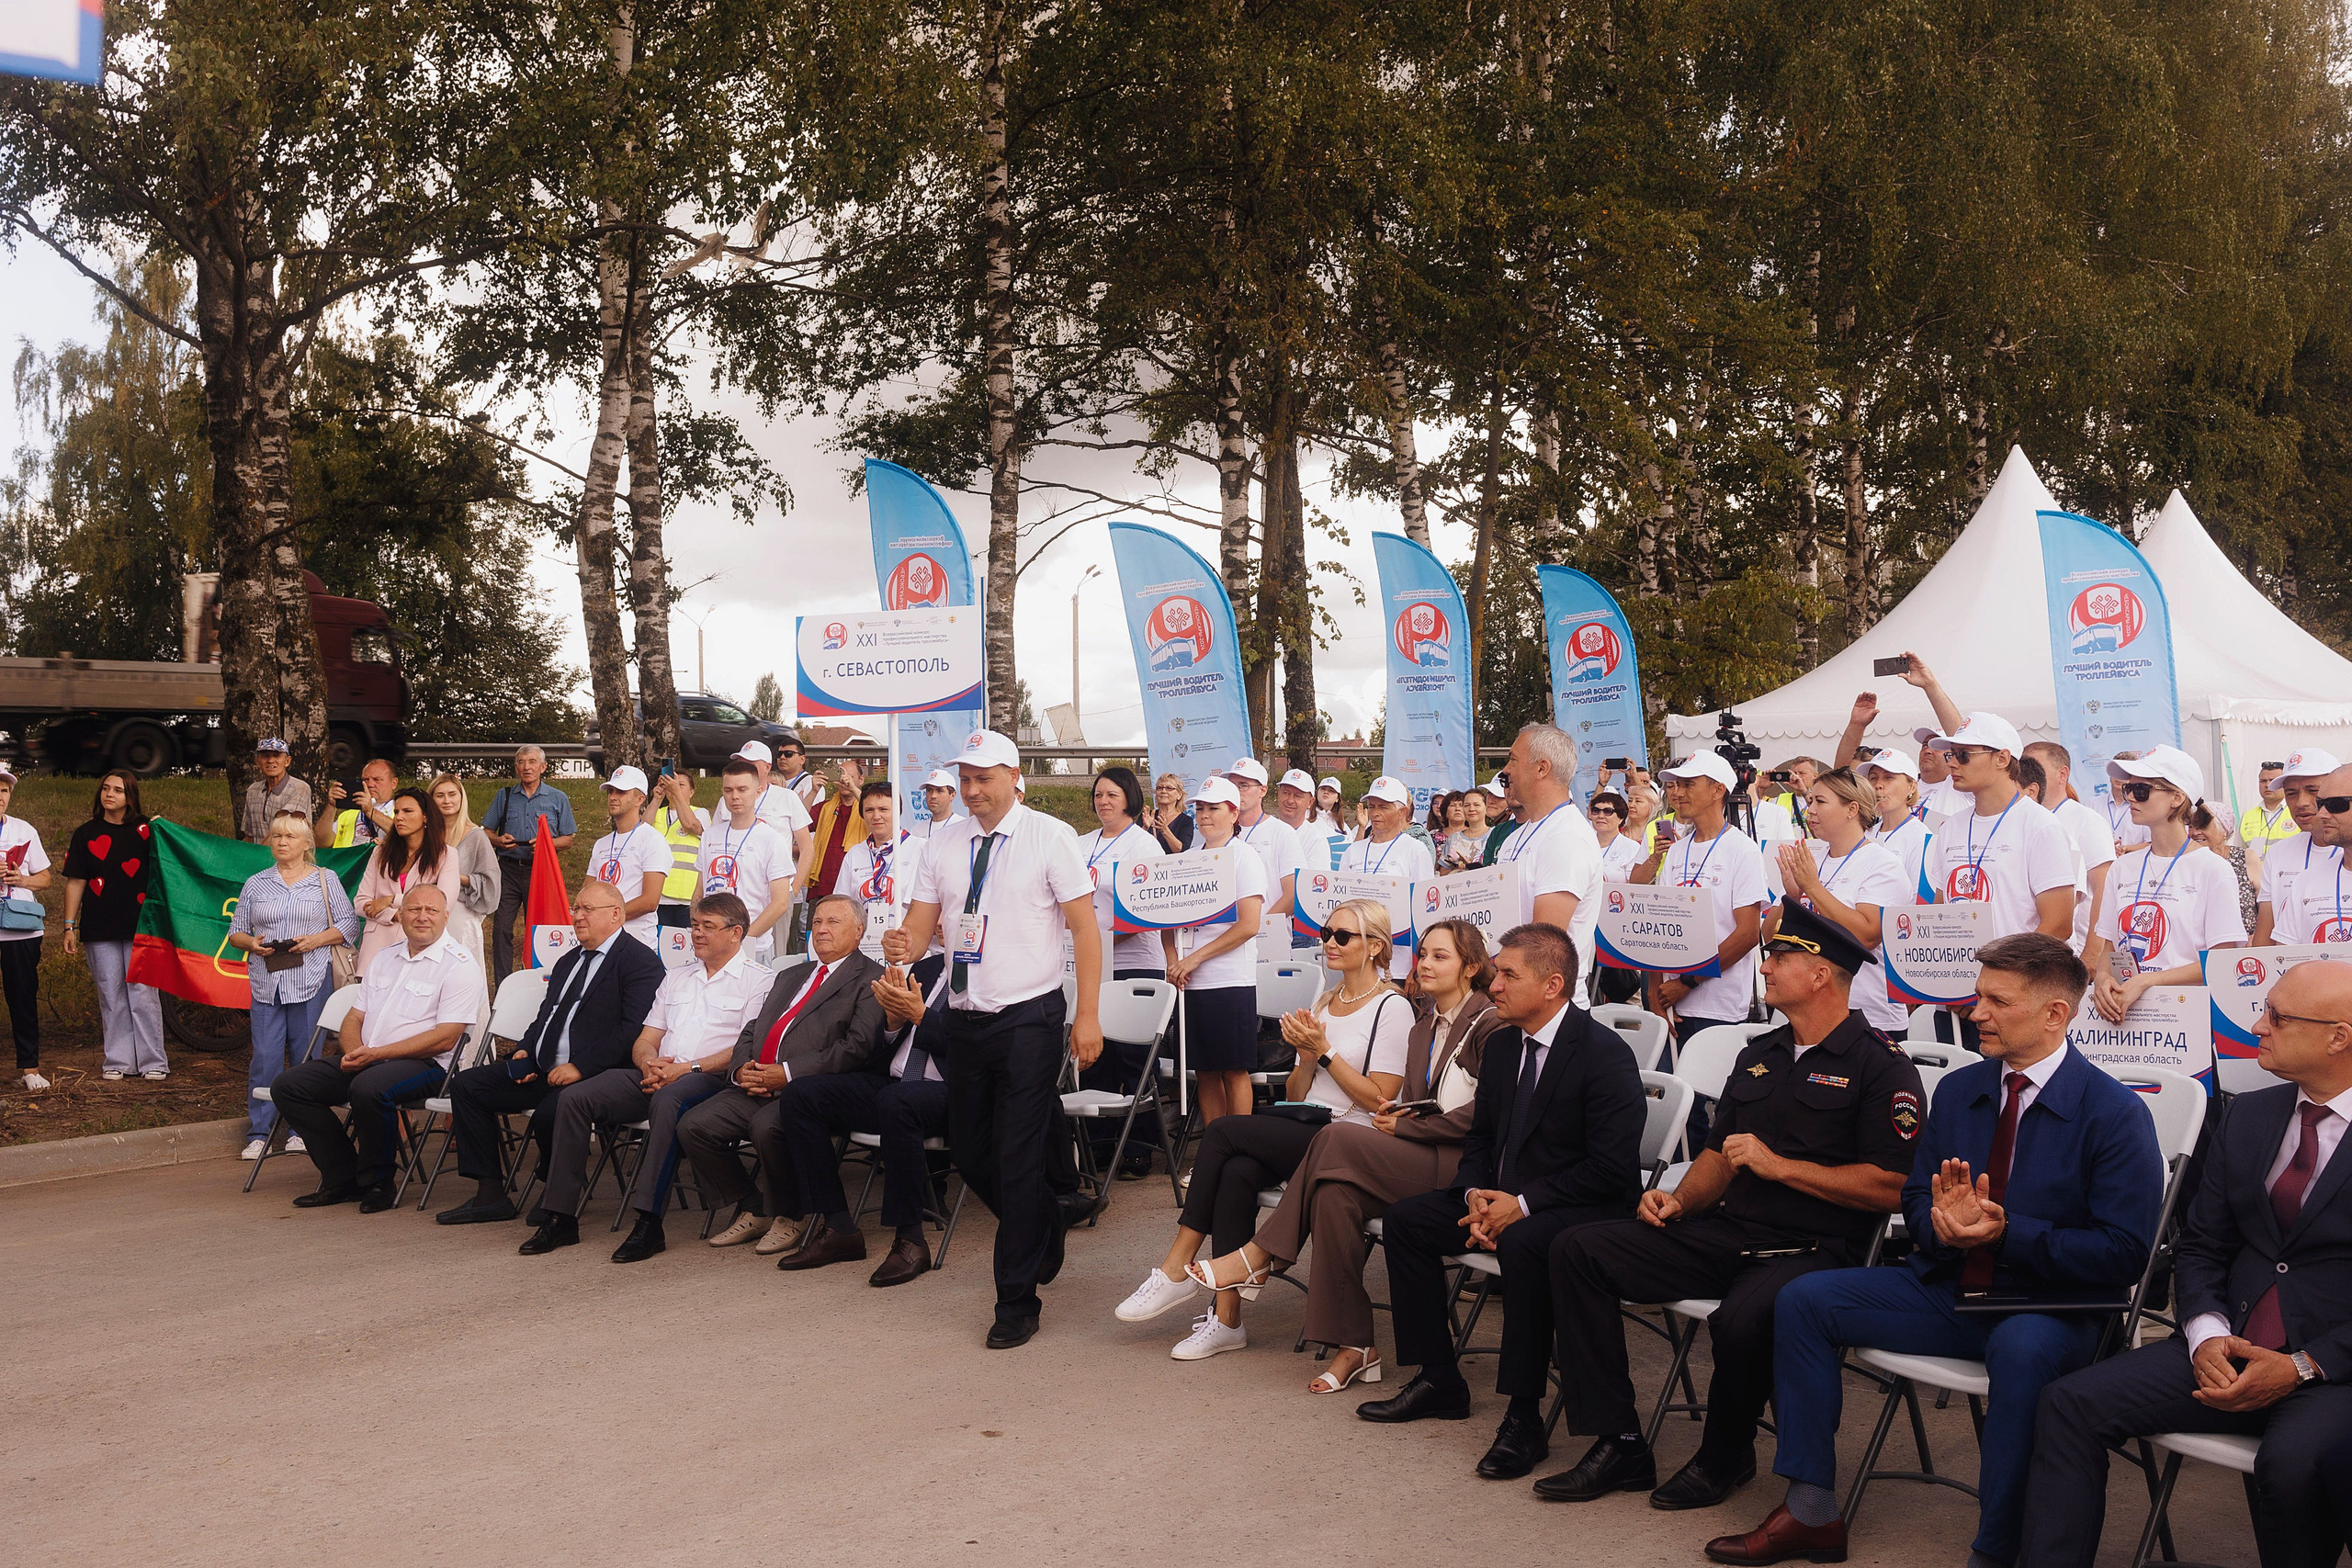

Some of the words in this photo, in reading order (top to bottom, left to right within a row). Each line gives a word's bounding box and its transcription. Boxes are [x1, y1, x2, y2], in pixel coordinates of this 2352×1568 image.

[856, 633, 877, 647] XXI
[822, 669, 831, 678] г.
[837, 658, 949, 677] СЕВАСТОПОЛЬ
[2064, 661, 2101, 673] ЛУЧШИЙ
[2103, 660, 2153, 670] ВОДИТЕЛЬ
[1148, 677, 1182, 691] ЛУЧШИЙ
[1182, 673, 1225, 685] ВОДИТЕЛЬ
[2075, 670, 2141, 681] ТРОЛЛЕЙБУСА
[1158, 683, 1217, 698] ТРОЛЛЕЙБУСА
[1561, 688, 1593, 699] ЛУЧШИЙ
[1593, 684, 1627, 695] ВОДИТЕЛЬ
[1570, 694, 1621, 705] ТРОЛЛЕЙБУСА
[1154, 870, 1168, 882] XXI
[1130, 894, 1136, 902] г.
[1139, 880, 1219, 900] СТЕРЛИТАМАК
[1333, 885, 1347, 895] XXI
[1132, 901, 1170, 913] Республика
[1170, 897, 1216, 908] Башкортостан
[1445, 895, 1458, 908] XXI
[1630, 902, 1645, 914] XXI
[1623, 924, 1629, 933] г.
[1632, 920, 1683, 937] САРАТОВ
[1917, 926, 1930, 939] XXI
[1620, 938, 1660, 950] Саратовская
[1661, 941, 1688, 952] область
[1896, 953, 1903, 962] г.
[1905, 969, 1951, 979] Новосибирская
[1952, 969, 1976, 978] область
[2251, 1002, 2263, 1011] г.
[2143, 1054, 2182, 1065] область
[1894, 1102, 1917, 1112] РОССИЯ
